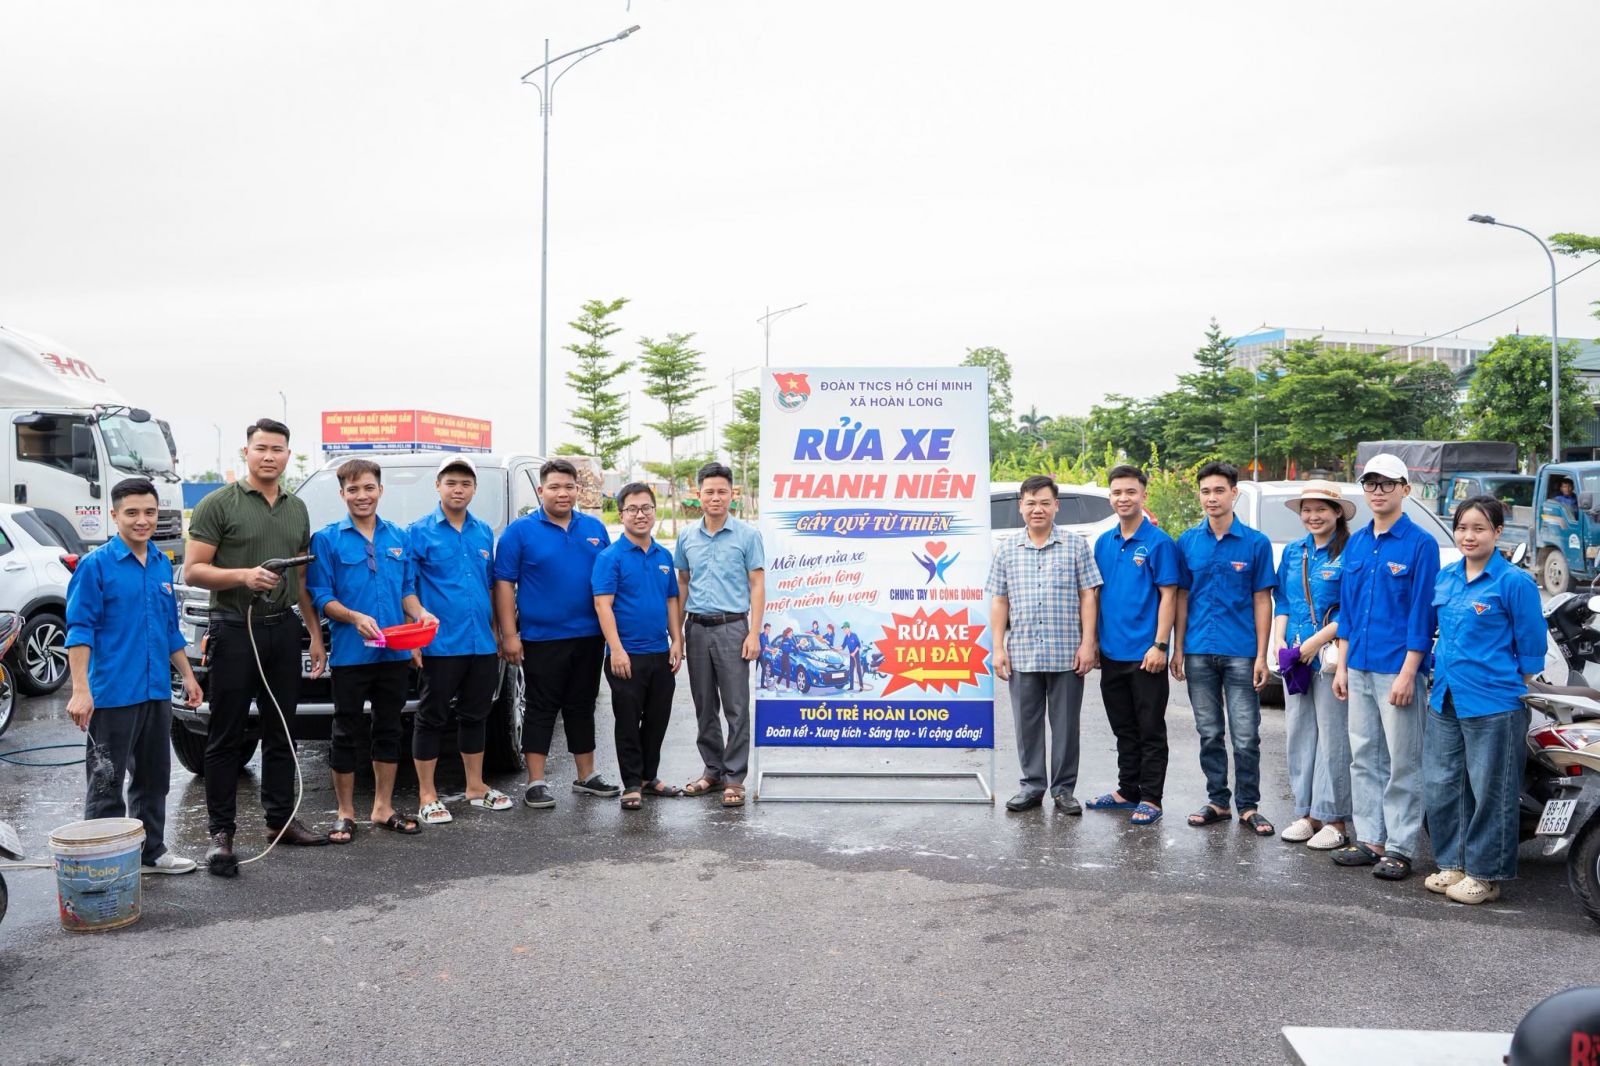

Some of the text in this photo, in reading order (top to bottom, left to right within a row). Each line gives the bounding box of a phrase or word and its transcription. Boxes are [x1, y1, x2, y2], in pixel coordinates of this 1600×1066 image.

[820, 378, 972, 391] ĐOÀN TNCS HỒ CHÍ MINH
[850, 396, 943, 407] XÃ HOÀN LONG
[794, 416, 955, 461] RỬA XE
[772, 468, 976, 499] THANH NIÊN
[796, 512, 952, 535] GÂY QUỸ TỪ THIỆN
[770, 549, 865, 570] Mỗi lượt rửa xe
[778, 570, 862, 590] một tấm lòng
[766, 589, 877, 612] một niềm hy vọng
[890, 588, 914, 600] CHUNG
[916, 589, 928, 600] TAY
[898, 618, 969, 640] RỬA XE
[895, 642, 972, 668] TẠI ĐÂY
[800, 702, 949, 720] TUỔI TRẺ HOÀN LONG
[766, 726, 791, 737] Đoàn
[793, 724, 808, 737] kết
[815, 727, 840, 740] Xung
[842, 726, 861, 737] kích
[868, 726, 892, 741] Sáng
[894, 728, 910, 741] tạo
[918, 726, 927, 738] Vì
[929, 726, 953, 741] cộng
[955, 724, 982, 741] đồng!
